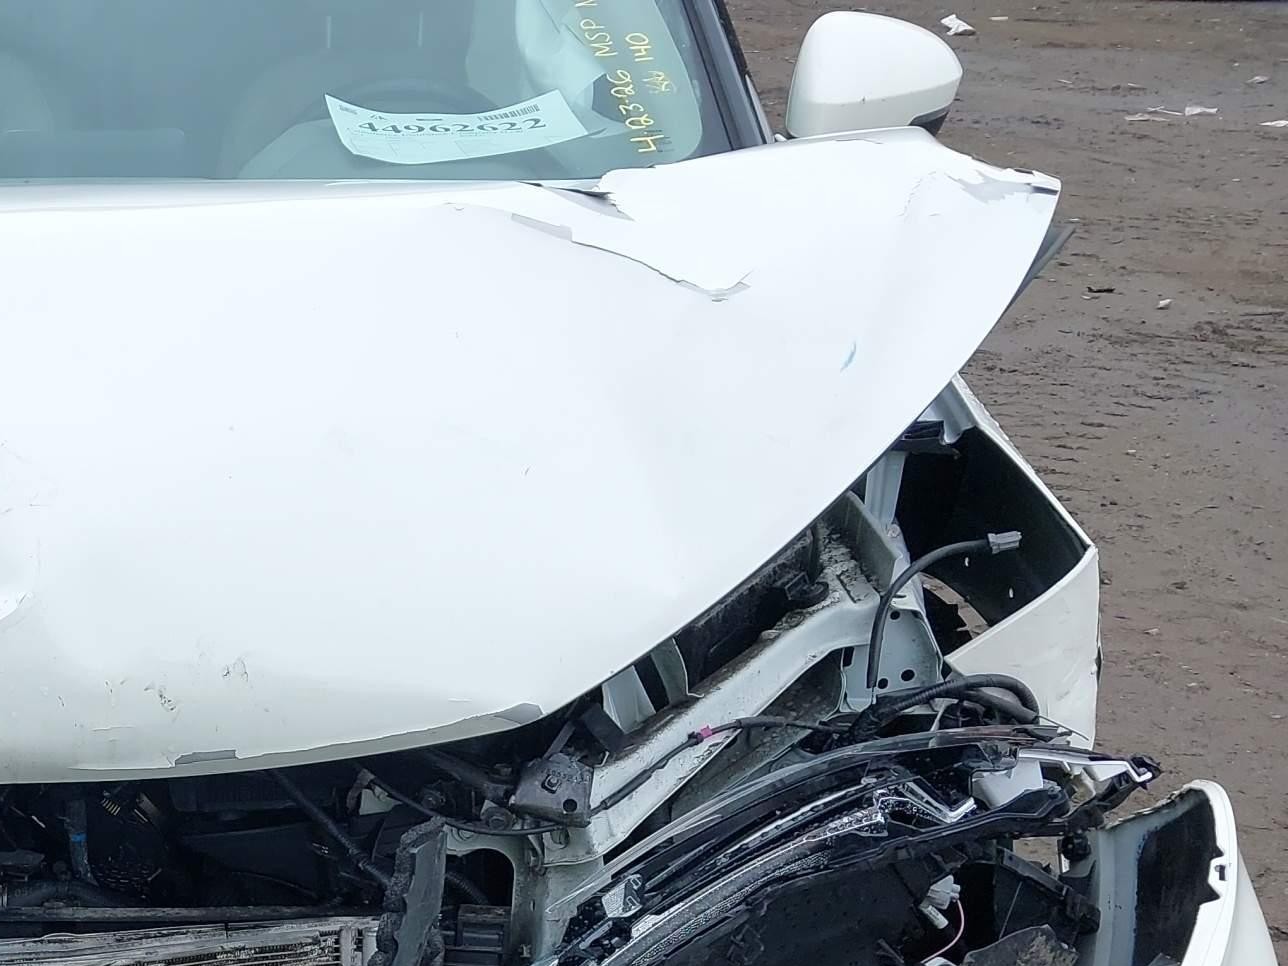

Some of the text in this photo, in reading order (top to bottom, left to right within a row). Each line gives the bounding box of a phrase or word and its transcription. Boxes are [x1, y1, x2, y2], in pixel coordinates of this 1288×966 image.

[579, 18, 619, 57] MSP
[624, 32, 655, 62] 140
[358, 117, 547, 135] 44962622
